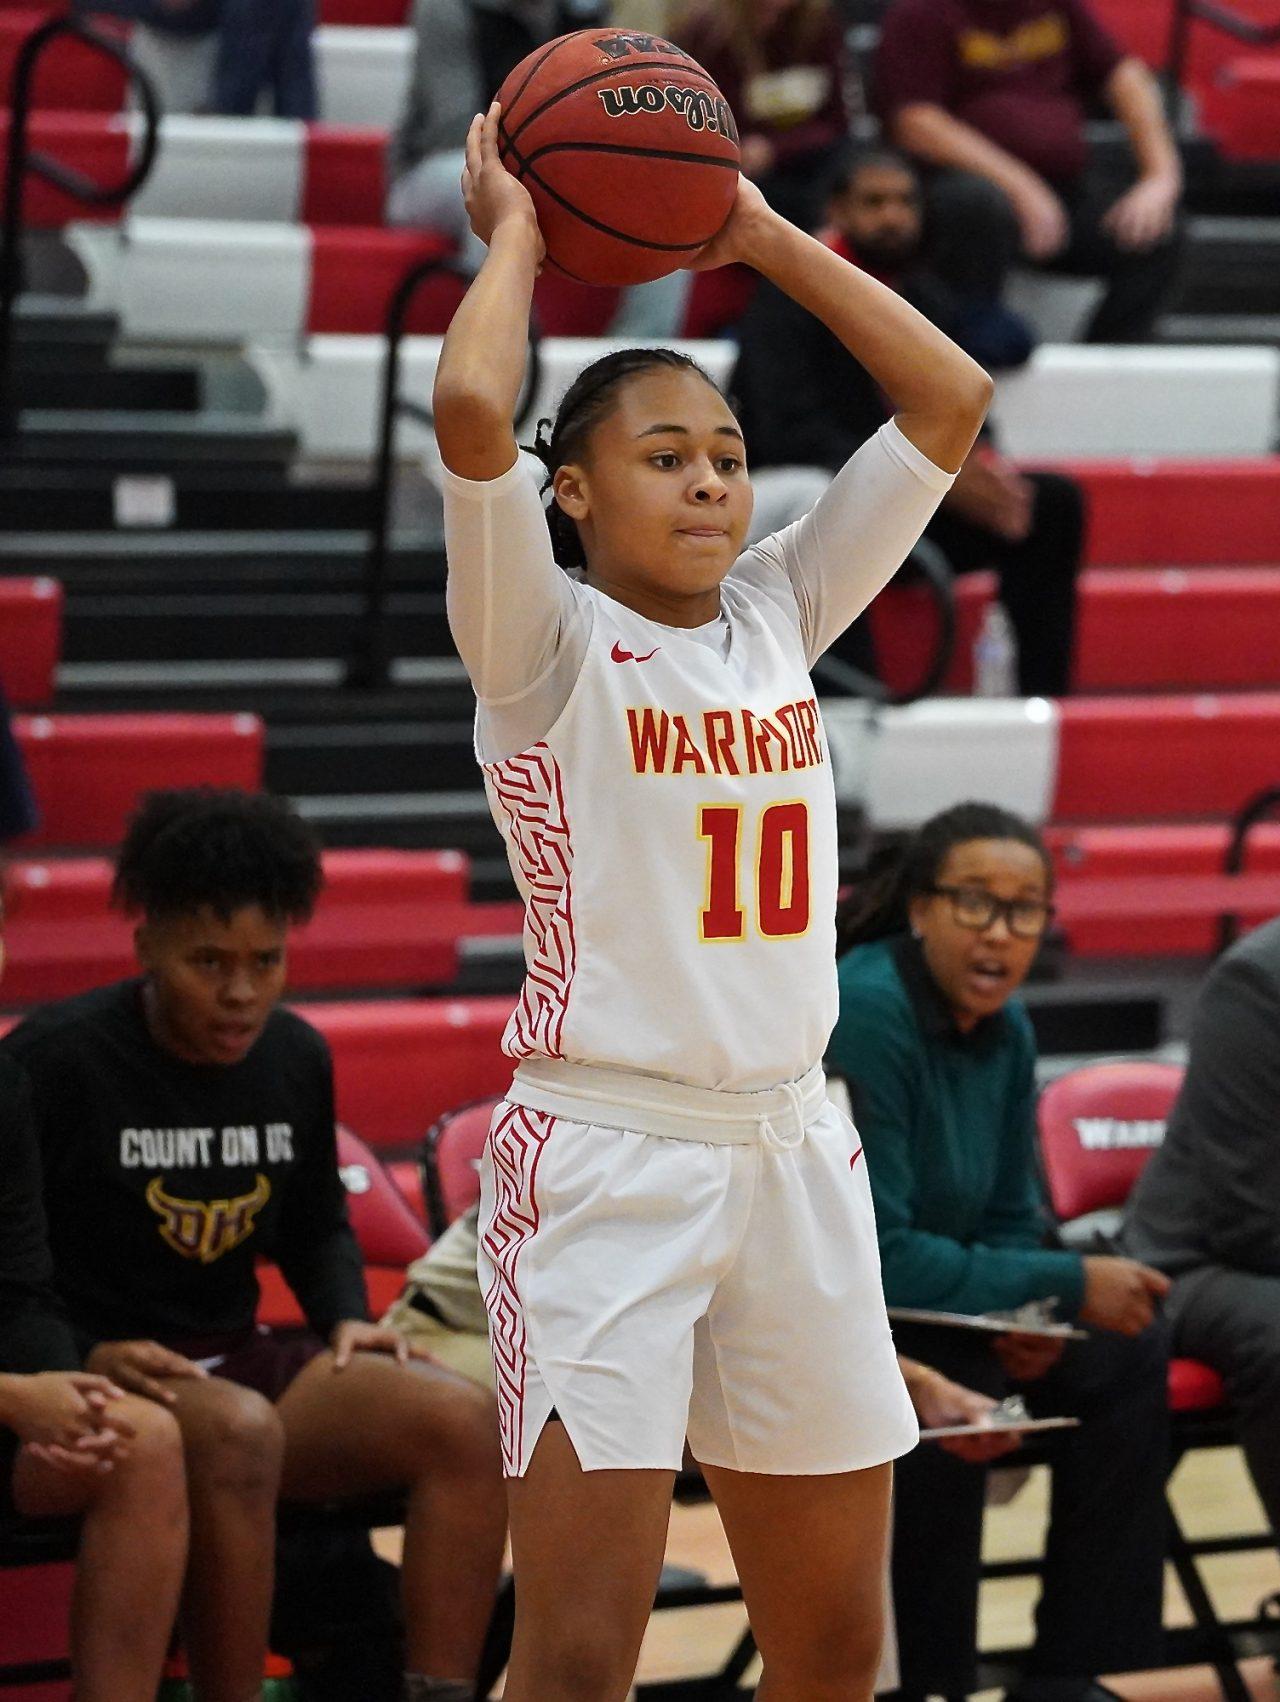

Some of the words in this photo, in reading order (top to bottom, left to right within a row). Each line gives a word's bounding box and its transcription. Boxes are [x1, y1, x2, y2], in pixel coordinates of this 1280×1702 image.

[698, 800, 814, 943] 10
[120, 1127, 215, 1169] COUNT
[221, 1125, 260, 1167] ON
